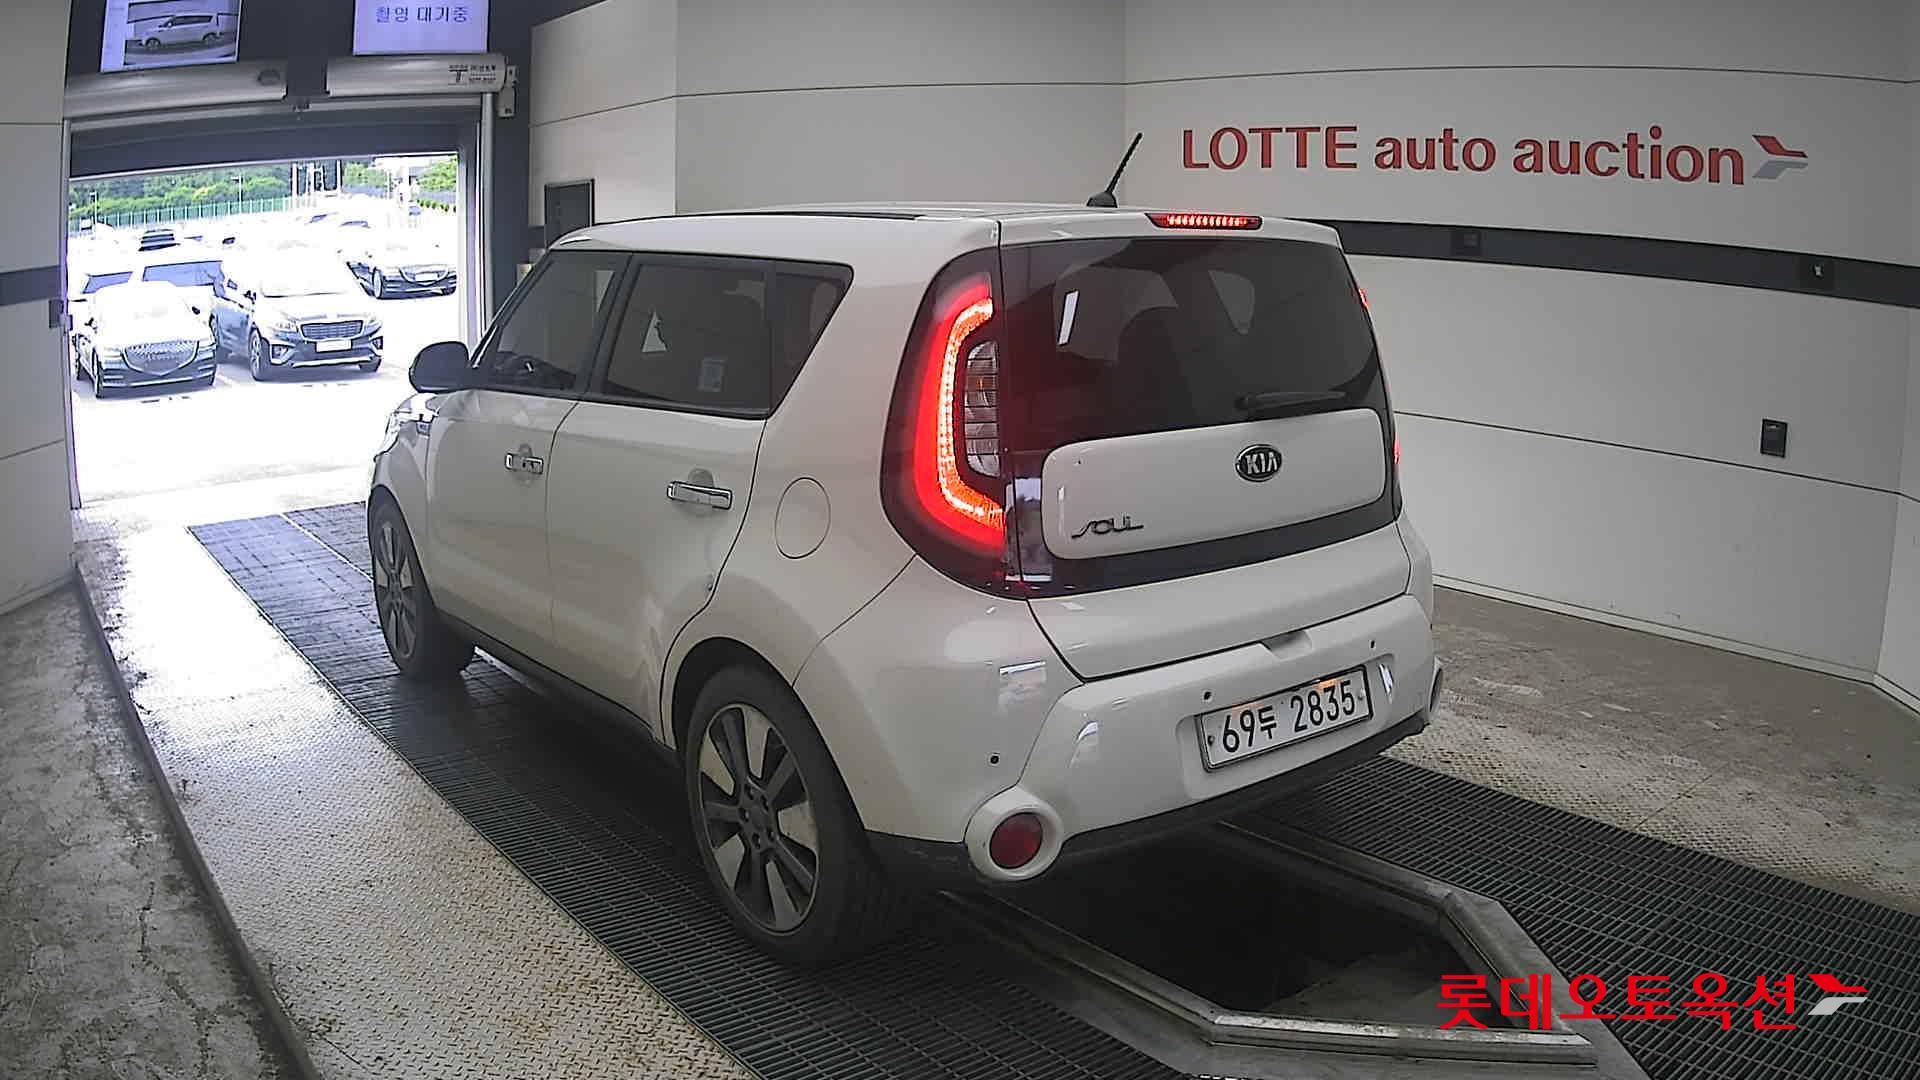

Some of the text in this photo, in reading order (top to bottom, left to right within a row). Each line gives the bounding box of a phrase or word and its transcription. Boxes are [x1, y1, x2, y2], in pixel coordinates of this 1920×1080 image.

[417, 7, 467, 23] 대기중
[1183, 124, 1744, 185] LOTTE auto auction
[1244, 451, 1278, 475] KIA
[1222, 679, 1356, 753] 69두 2835
